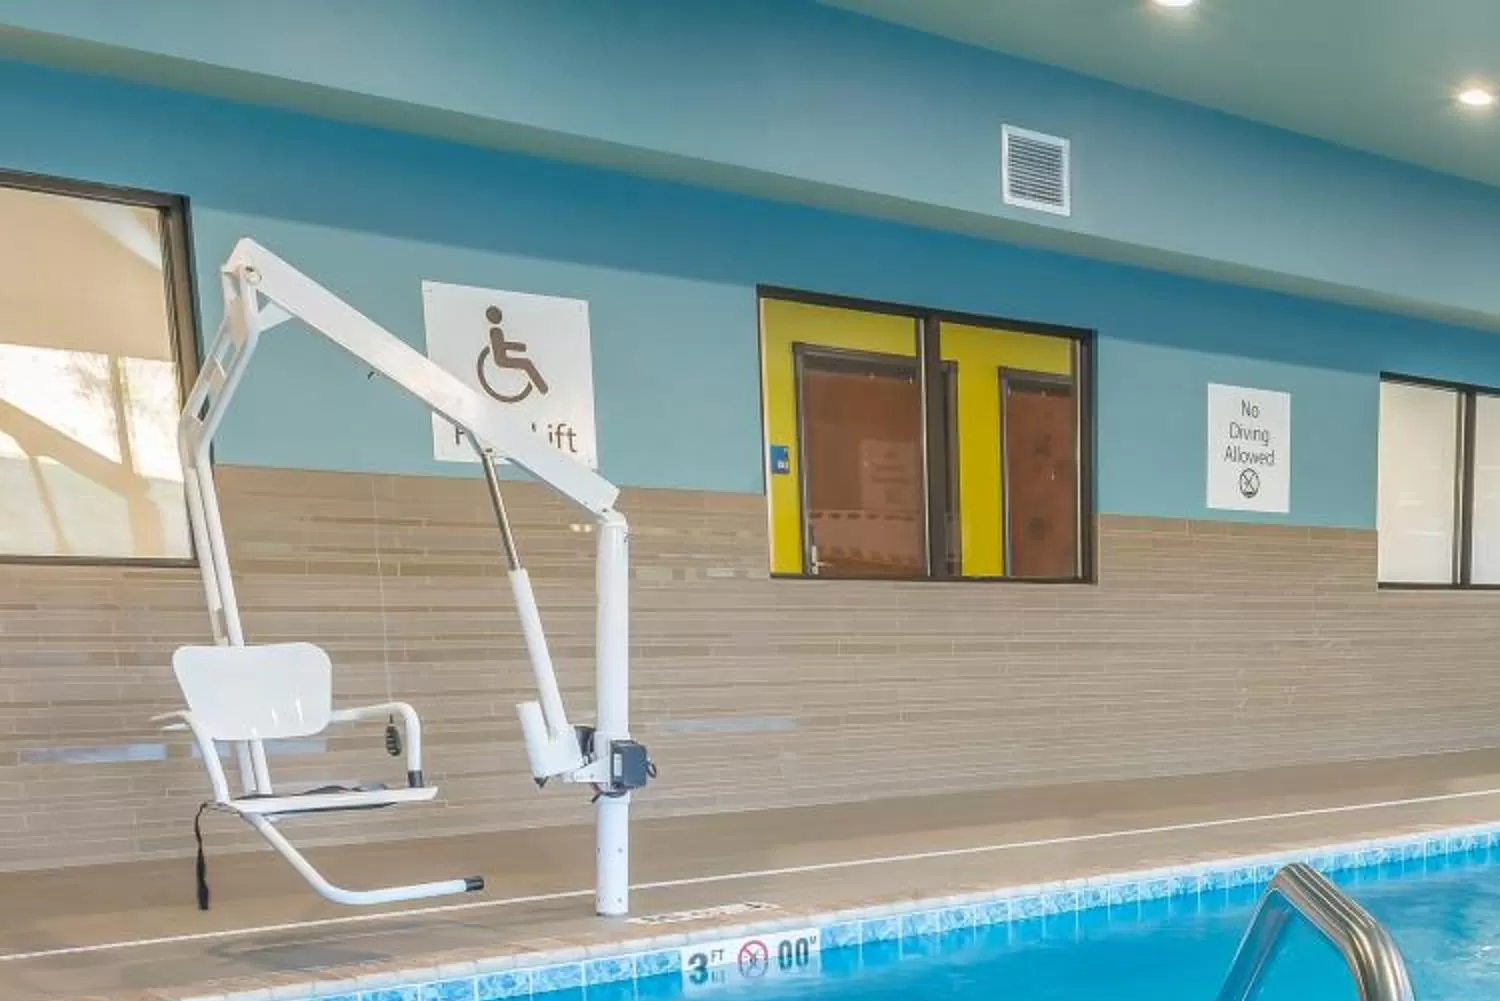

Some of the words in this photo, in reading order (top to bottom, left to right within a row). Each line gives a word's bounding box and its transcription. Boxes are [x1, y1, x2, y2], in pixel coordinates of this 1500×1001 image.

[1241, 400, 1259, 418] No
[1229, 421, 1269, 446] Diving
[1224, 446, 1275, 466] Allowed
[688, 953, 709, 984] 3
[712, 949, 724, 963] FT
